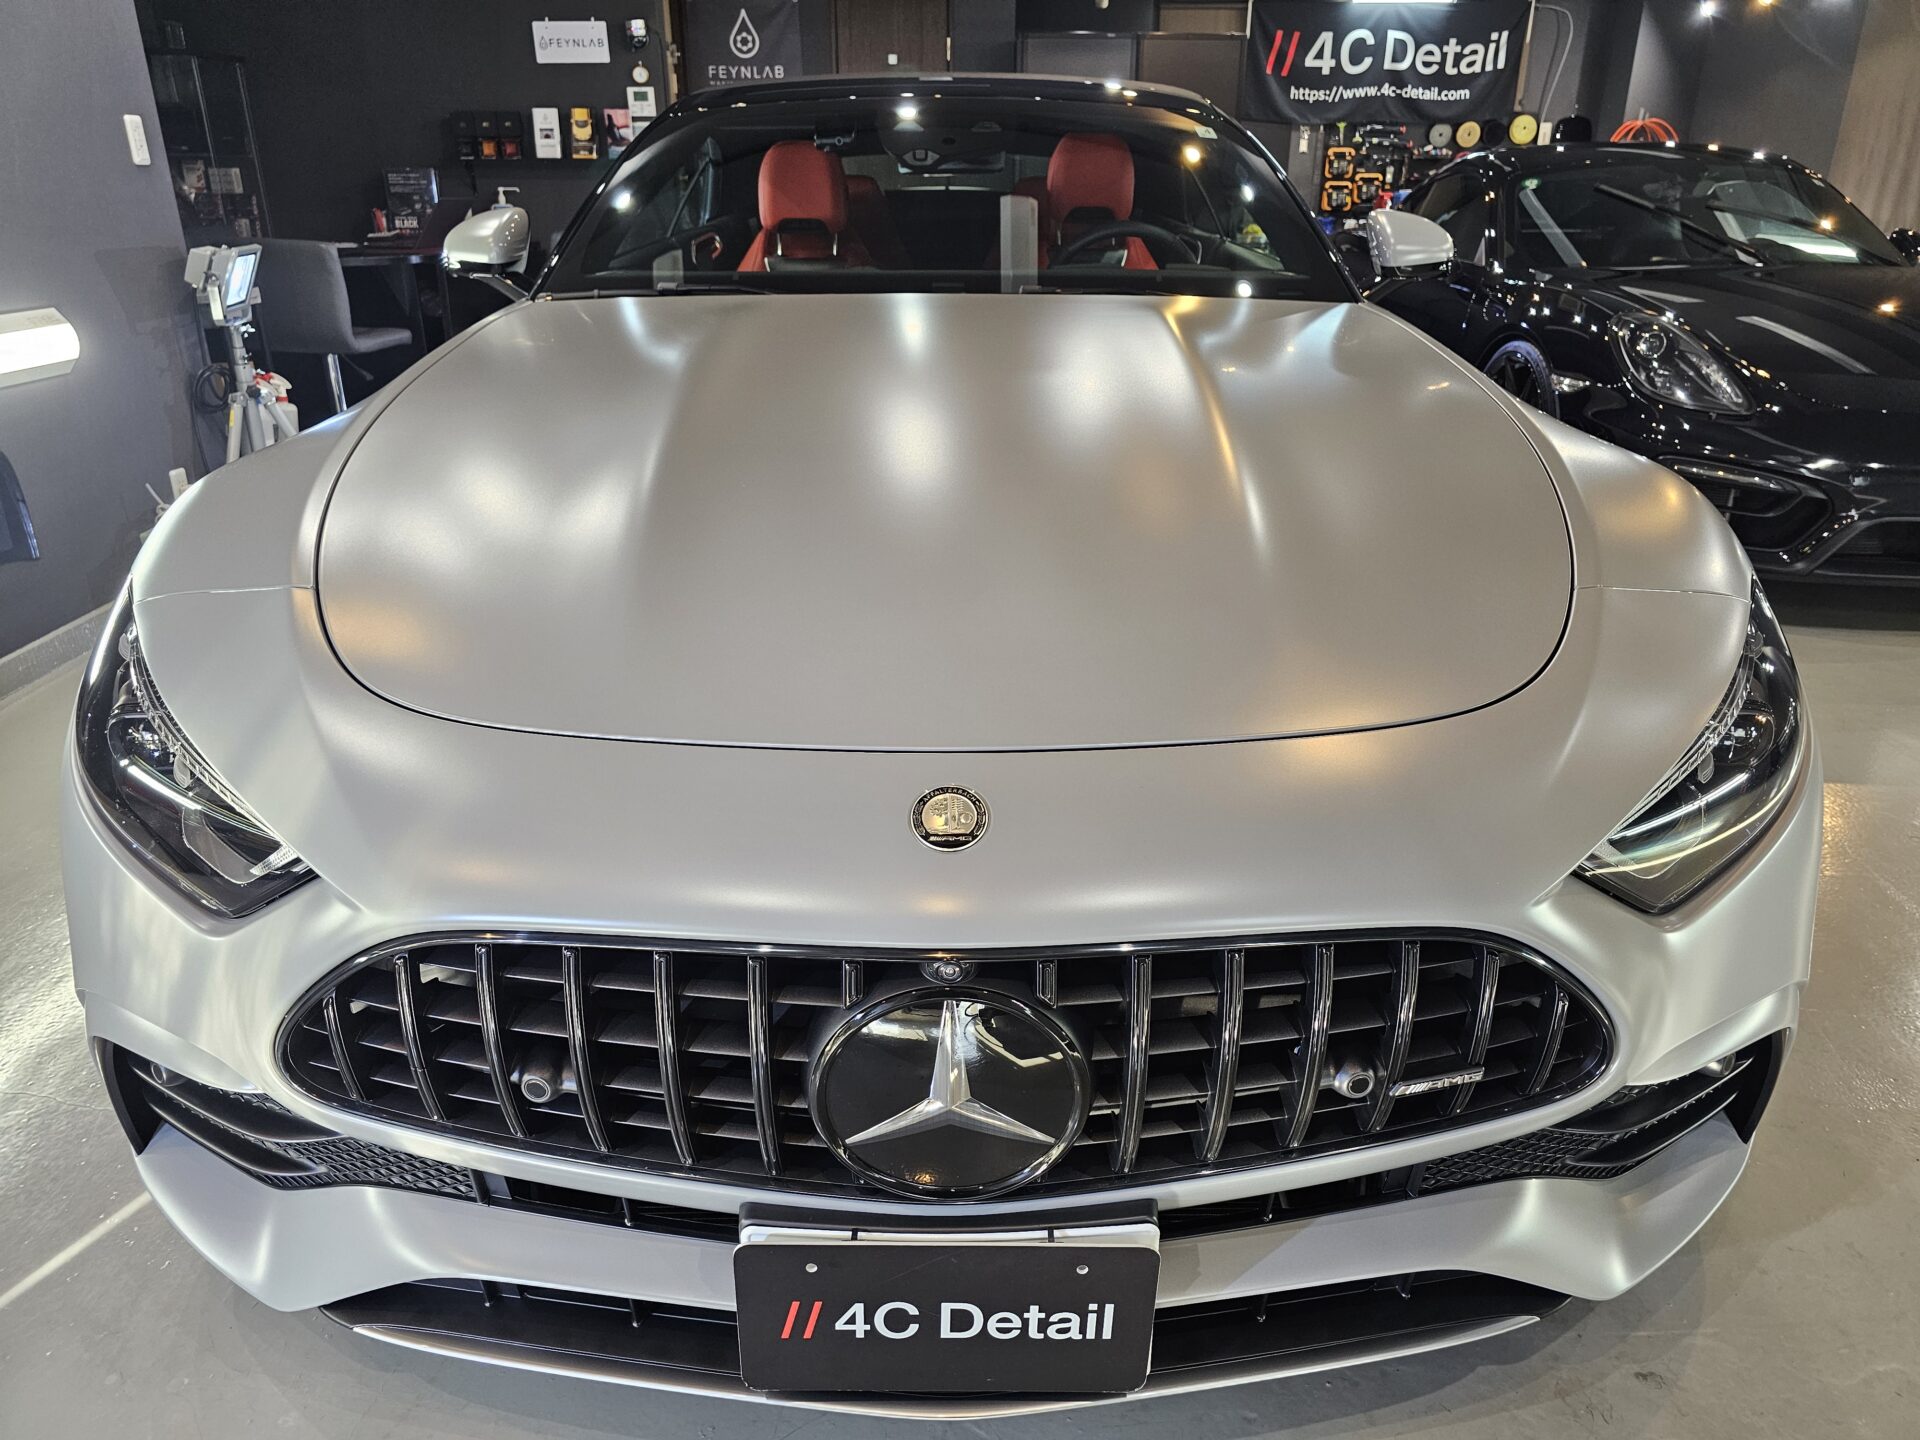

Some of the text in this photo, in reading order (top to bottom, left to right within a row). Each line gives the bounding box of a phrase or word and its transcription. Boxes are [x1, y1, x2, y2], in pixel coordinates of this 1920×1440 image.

[549, 38, 605, 48] FEYNLAB
[1383, 29, 1510, 76] Detail
[708, 65, 785, 79] FEYNLAB
[1290, 82, 1471, 103] https://www.4c-detail.com
[940, 1303, 1115, 1340] Detail
